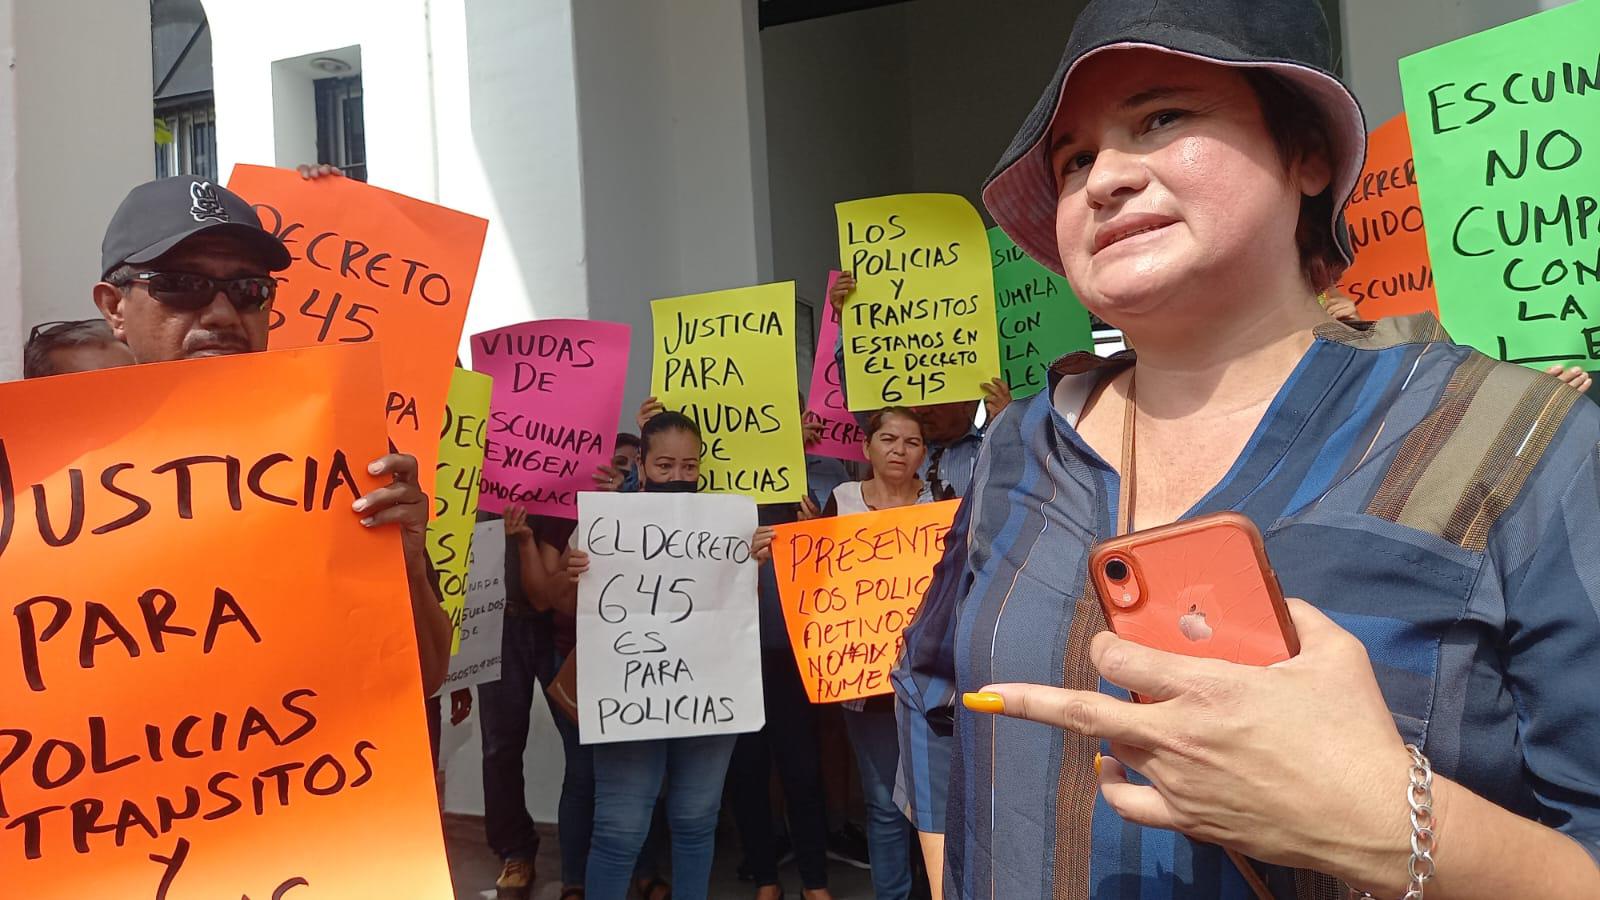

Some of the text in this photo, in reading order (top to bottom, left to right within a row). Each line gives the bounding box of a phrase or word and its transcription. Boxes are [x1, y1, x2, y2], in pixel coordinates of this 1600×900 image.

[1486, 130, 1582, 186] NO
[848, 215, 906, 246] LOS
[1349, 206, 1424, 254] NIDO
[1453, 194, 1600, 257] CUMP
[853, 243, 960, 280] POLICIAS
[1503, 248, 1600, 291] CON
[890, 279, 904, 299] Y
[998, 277, 1058, 310] UMPLA
[1336, 265, 1433, 305] SCUIN
[851, 295, 978, 329] TRANSITOS
[1000, 312, 1040, 339] CON
[1518, 295, 1587, 322] LA
[480, 333, 596, 367] VIUDAS
[664, 311, 783, 354] JUSTICIA
[852, 328, 977, 355] ESTAMOS EN
[864, 351, 977, 374] EL DECRETO
[1006, 342, 1039, 361] LA
[512, 362, 557, 393] DE
[665, 357, 744, 392] PARA
[881, 372, 945, 402] 645
[491, 412, 602, 454] SCUINAPA
[485, 439, 579, 478] EXIGEN
[697, 467, 790, 493] OLICIAS
[588, 517, 750, 564] EL DECRETO
[599, 574, 696, 624] 645
[799, 576, 929, 615] LOS POLIC
[14, 587, 261, 692] PARA
[614, 631, 667, 655] ES
[624, 659, 693, 692] PARA
[598, 695, 734, 734] POLICIAS
[6, 741, 378, 859] TRANSITOS
